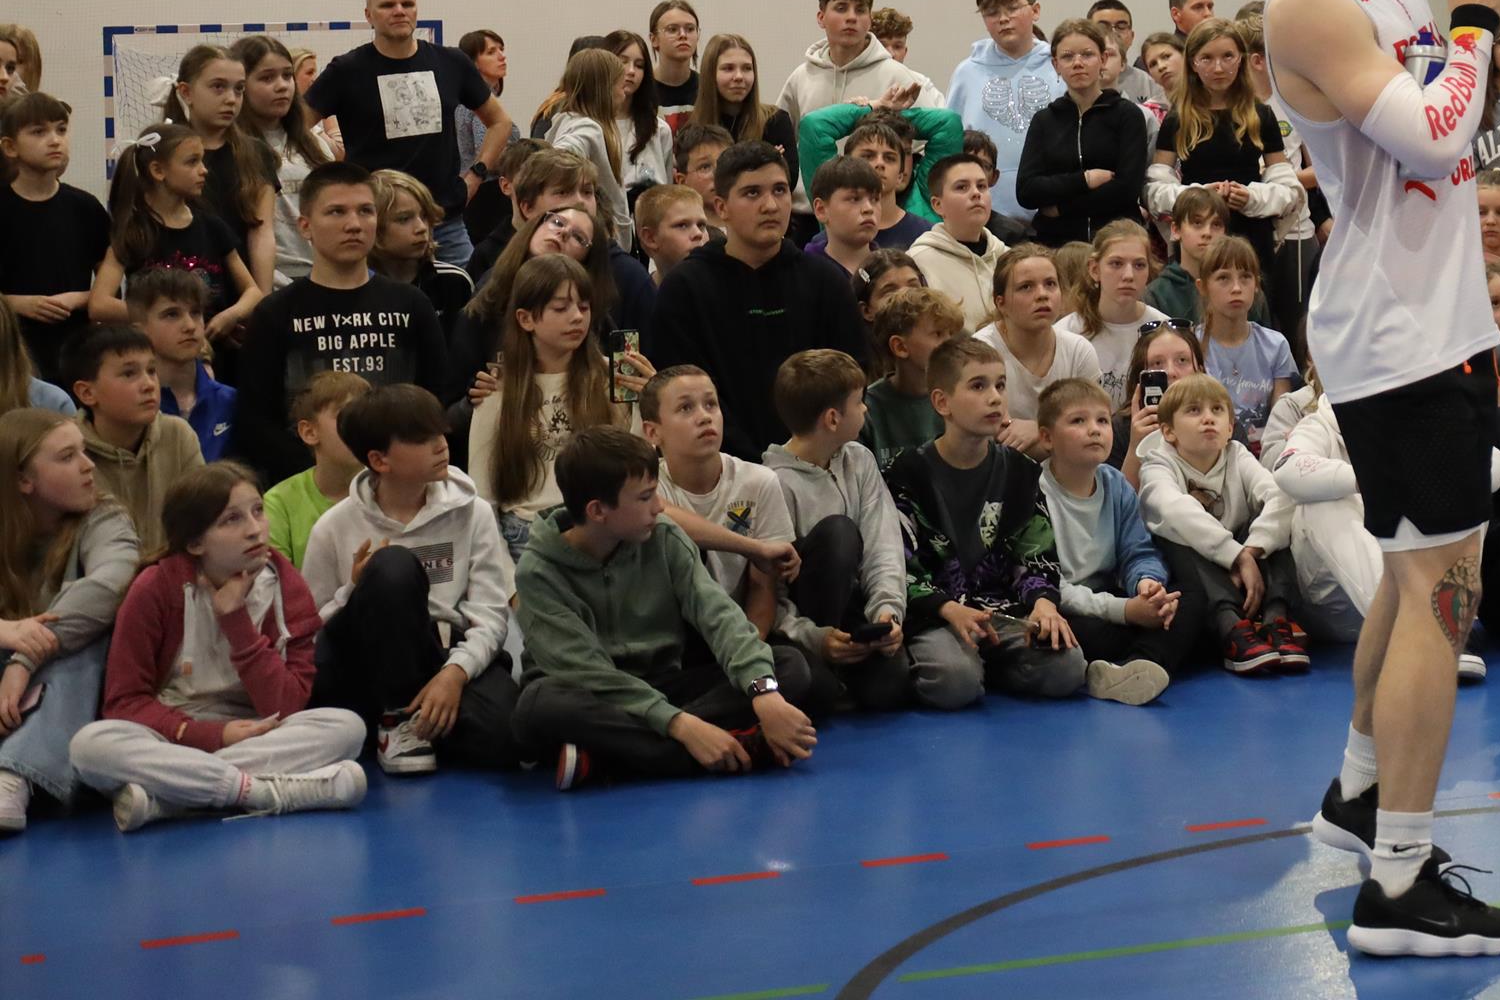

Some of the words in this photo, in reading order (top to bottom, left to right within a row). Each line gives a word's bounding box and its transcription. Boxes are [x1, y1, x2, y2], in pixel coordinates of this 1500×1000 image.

[293, 315, 326, 332] NEW
[378, 312, 410, 328] CITY
[317, 335, 343, 351] BIG
[350, 333, 396, 350] APPLE
[333, 355, 384, 372] EST.93
